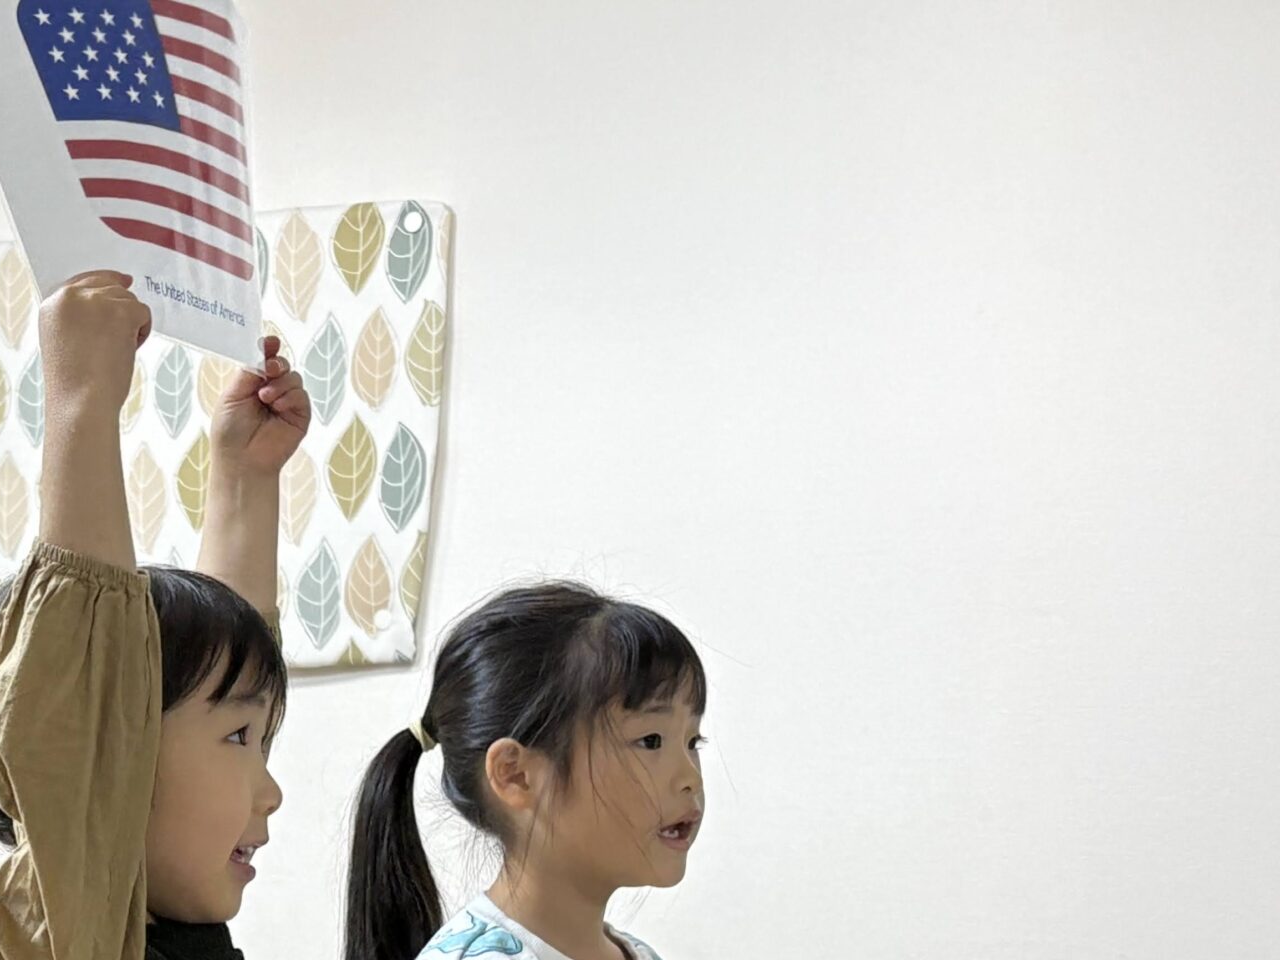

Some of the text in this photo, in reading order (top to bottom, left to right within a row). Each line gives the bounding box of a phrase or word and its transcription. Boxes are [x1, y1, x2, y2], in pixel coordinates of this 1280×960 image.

[144, 276, 246, 326] The United States of America
